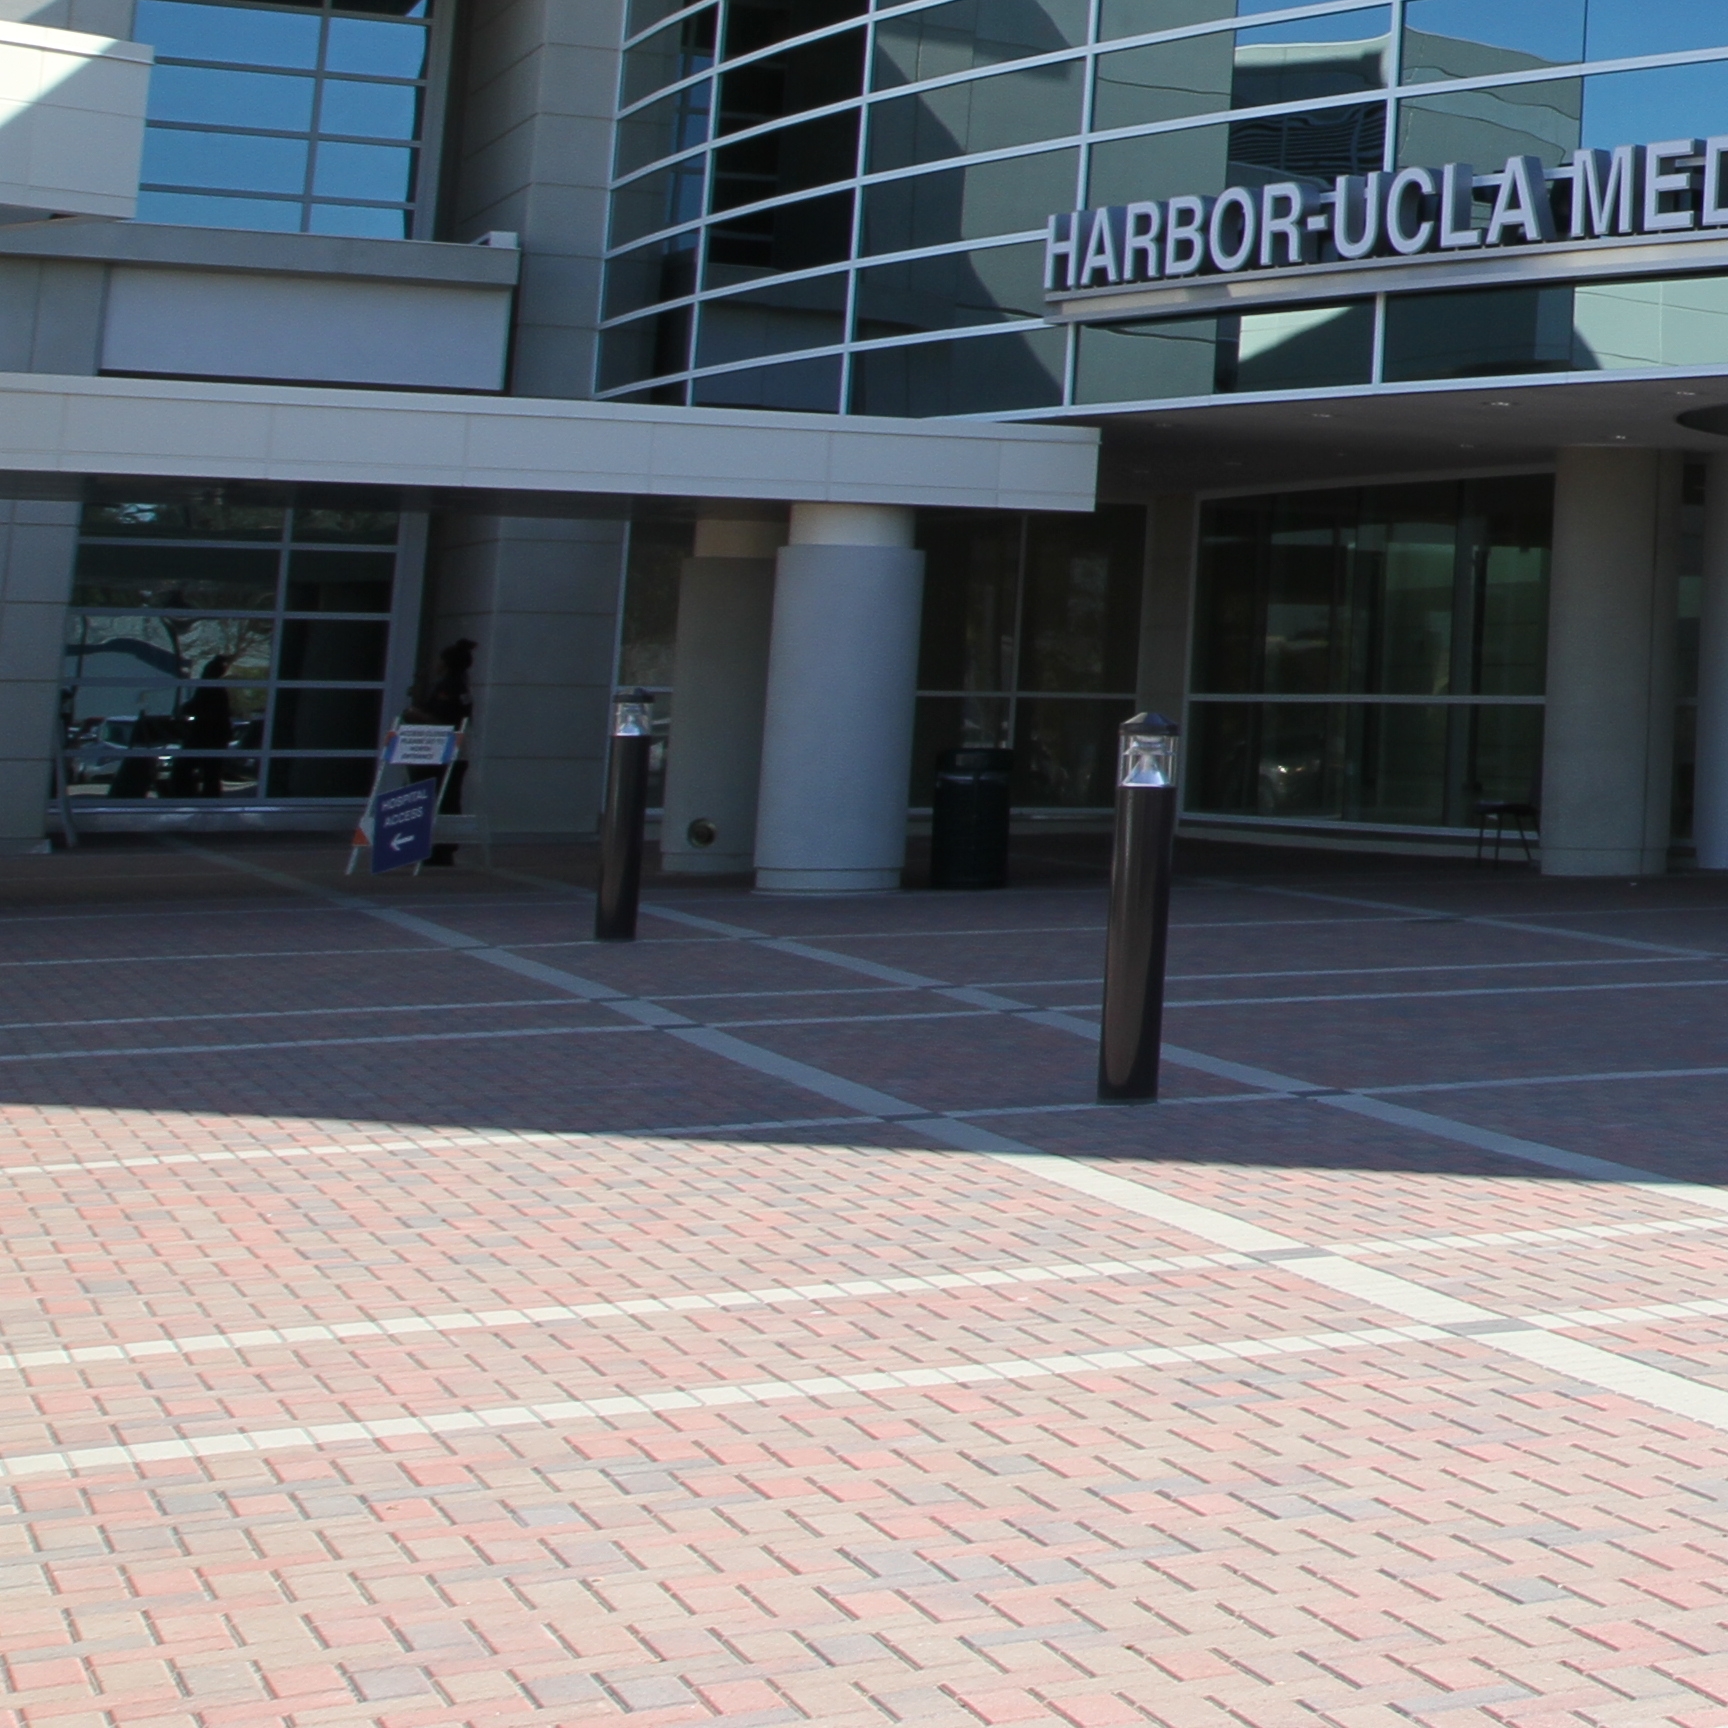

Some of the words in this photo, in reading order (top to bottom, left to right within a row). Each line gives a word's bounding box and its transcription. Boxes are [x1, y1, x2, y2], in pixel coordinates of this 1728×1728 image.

[1043, 154, 1548, 291] HARBOR-UCLA
[382, 789, 428, 809] HOSPITAL
[384, 806, 423, 828] ACCESS
